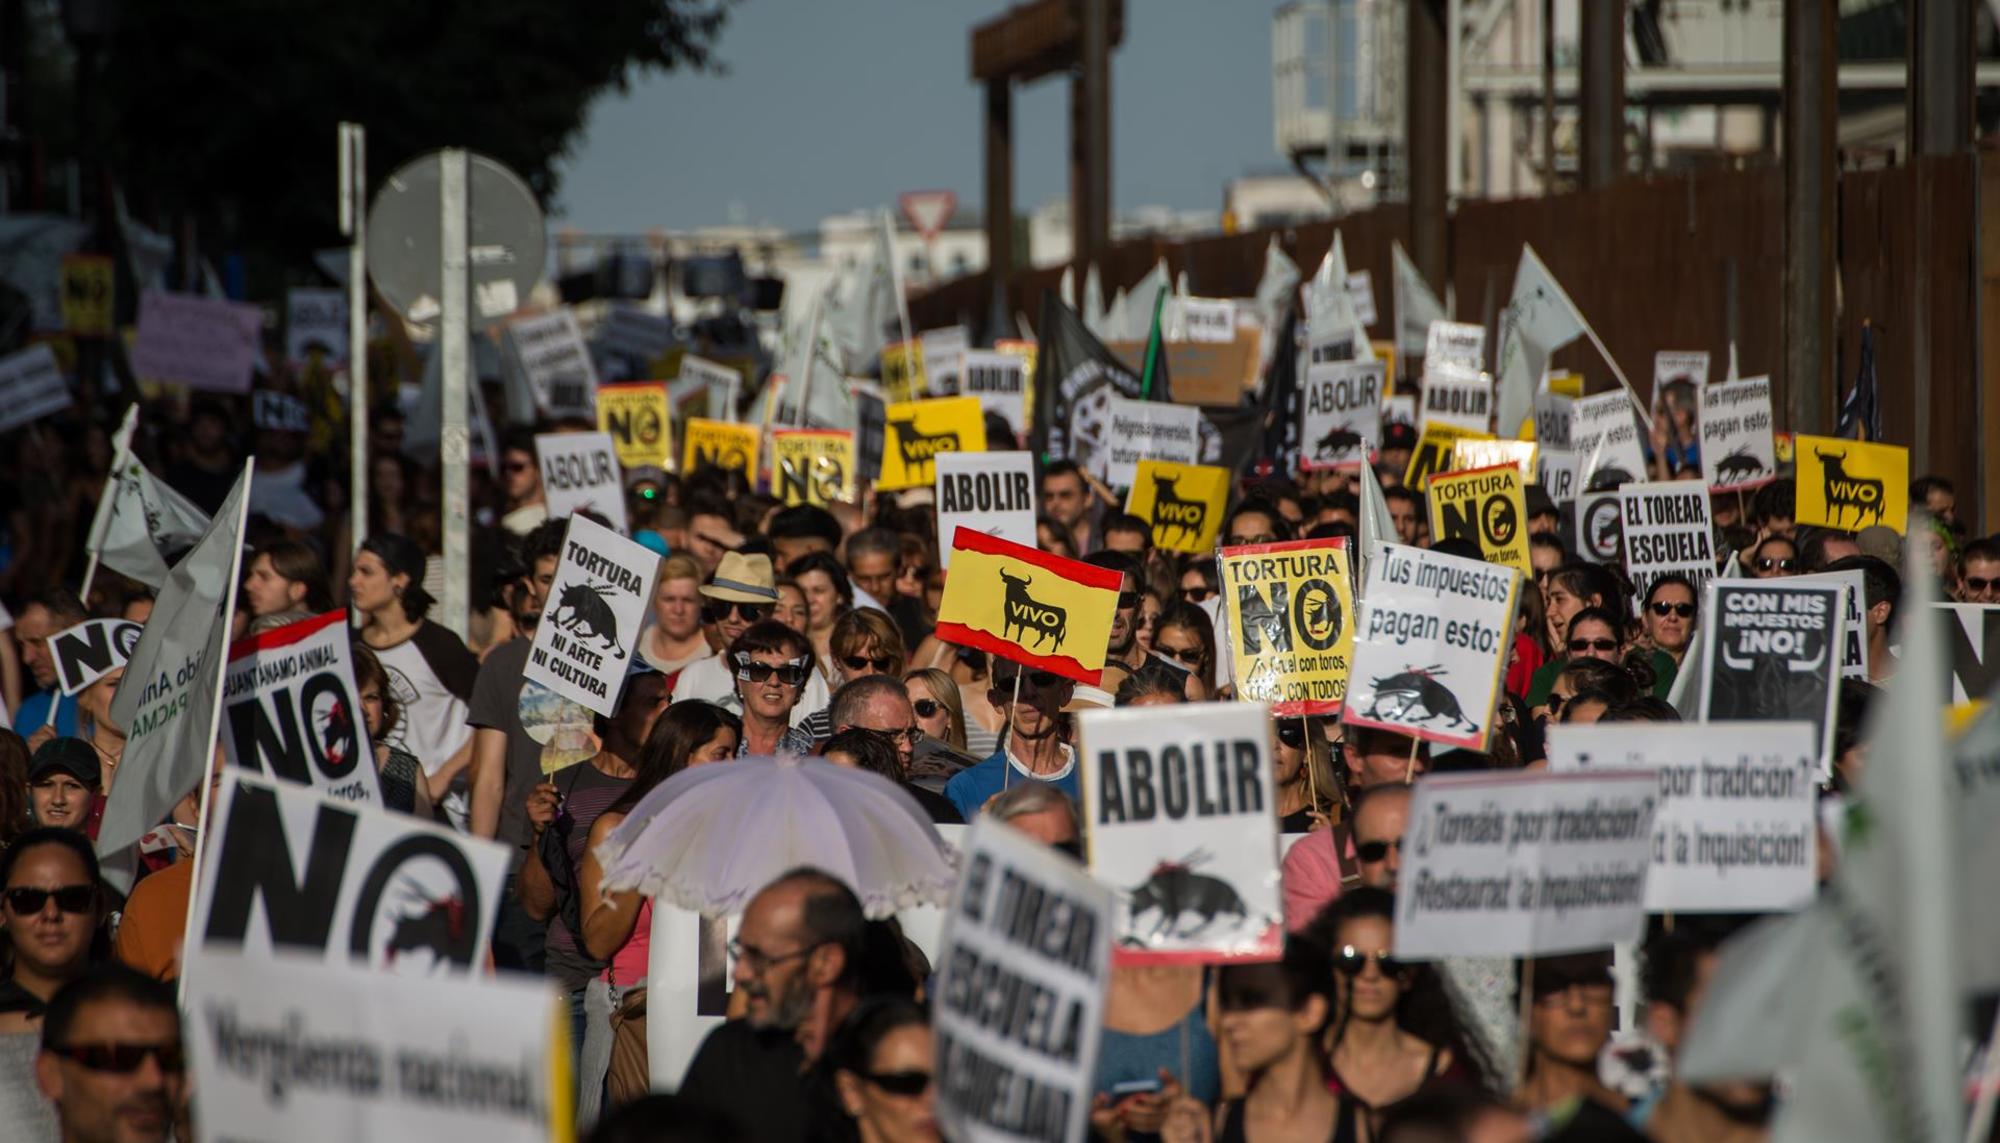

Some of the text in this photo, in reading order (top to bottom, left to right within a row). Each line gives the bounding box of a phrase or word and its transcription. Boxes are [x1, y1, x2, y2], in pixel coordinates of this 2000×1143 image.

[1308, 374, 1377, 415] ABOLIR
[1428, 386, 1487, 415] ABOLIR
[1720, 382, 1768, 406] impuestos
[607, 405, 661, 446] NO
[1703, 417, 1740, 442] pagan
[903, 438, 956, 459] VIVO
[544, 451, 615, 490] ABOLIR
[780, 456, 845, 502] NO
[1434, 473, 1515, 501] TORTURA
[941, 472, 1031, 513] ABOLIR
[1830, 479, 1877, 502] VIVO
[1158, 502, 1202, 523] VIVO
[1441, 494, 1518, 547] NO
[1625, 494, 1708, 526] EL TOREAR,
[1629, 531, 1711, 564] ESCUELA
[568, 540, 642, 597] TORTURA
[1229, 553, 1340, 583] TORTURA
[1381, 546, 1509, 603] Tus impuestos
[1011, 601, 1059, 627] VIVO
[1238, 578, 1343, 656] NO
[1725, 592, 1778, 612] CON
[1782, 593, 1827, 614] MIS
[1370, 608, 1501, 655] pagan esto:
[1724, 612, 1825, 630] IMPUESTOS
[55, 622, 144, 692] NO
[300, 642, 338, 675] ANIMAL
[551, 633, 603, 671] NI ARTE
[1738, 629, 1806, 656] ¡NO!
[531, 648, 607, 699] NI CULTURA
[1299, 657, 1317, 672] con
[1319, 654, 1348, 672] toros,
[1287, 681, 1310, 701] CON
[1311, 679, 1346, 699] TODOS
[227, 672, 359, 786] NO
[1096, 738, 1264, 825] ABOLIR
[204, 777, 481, 972] NO
